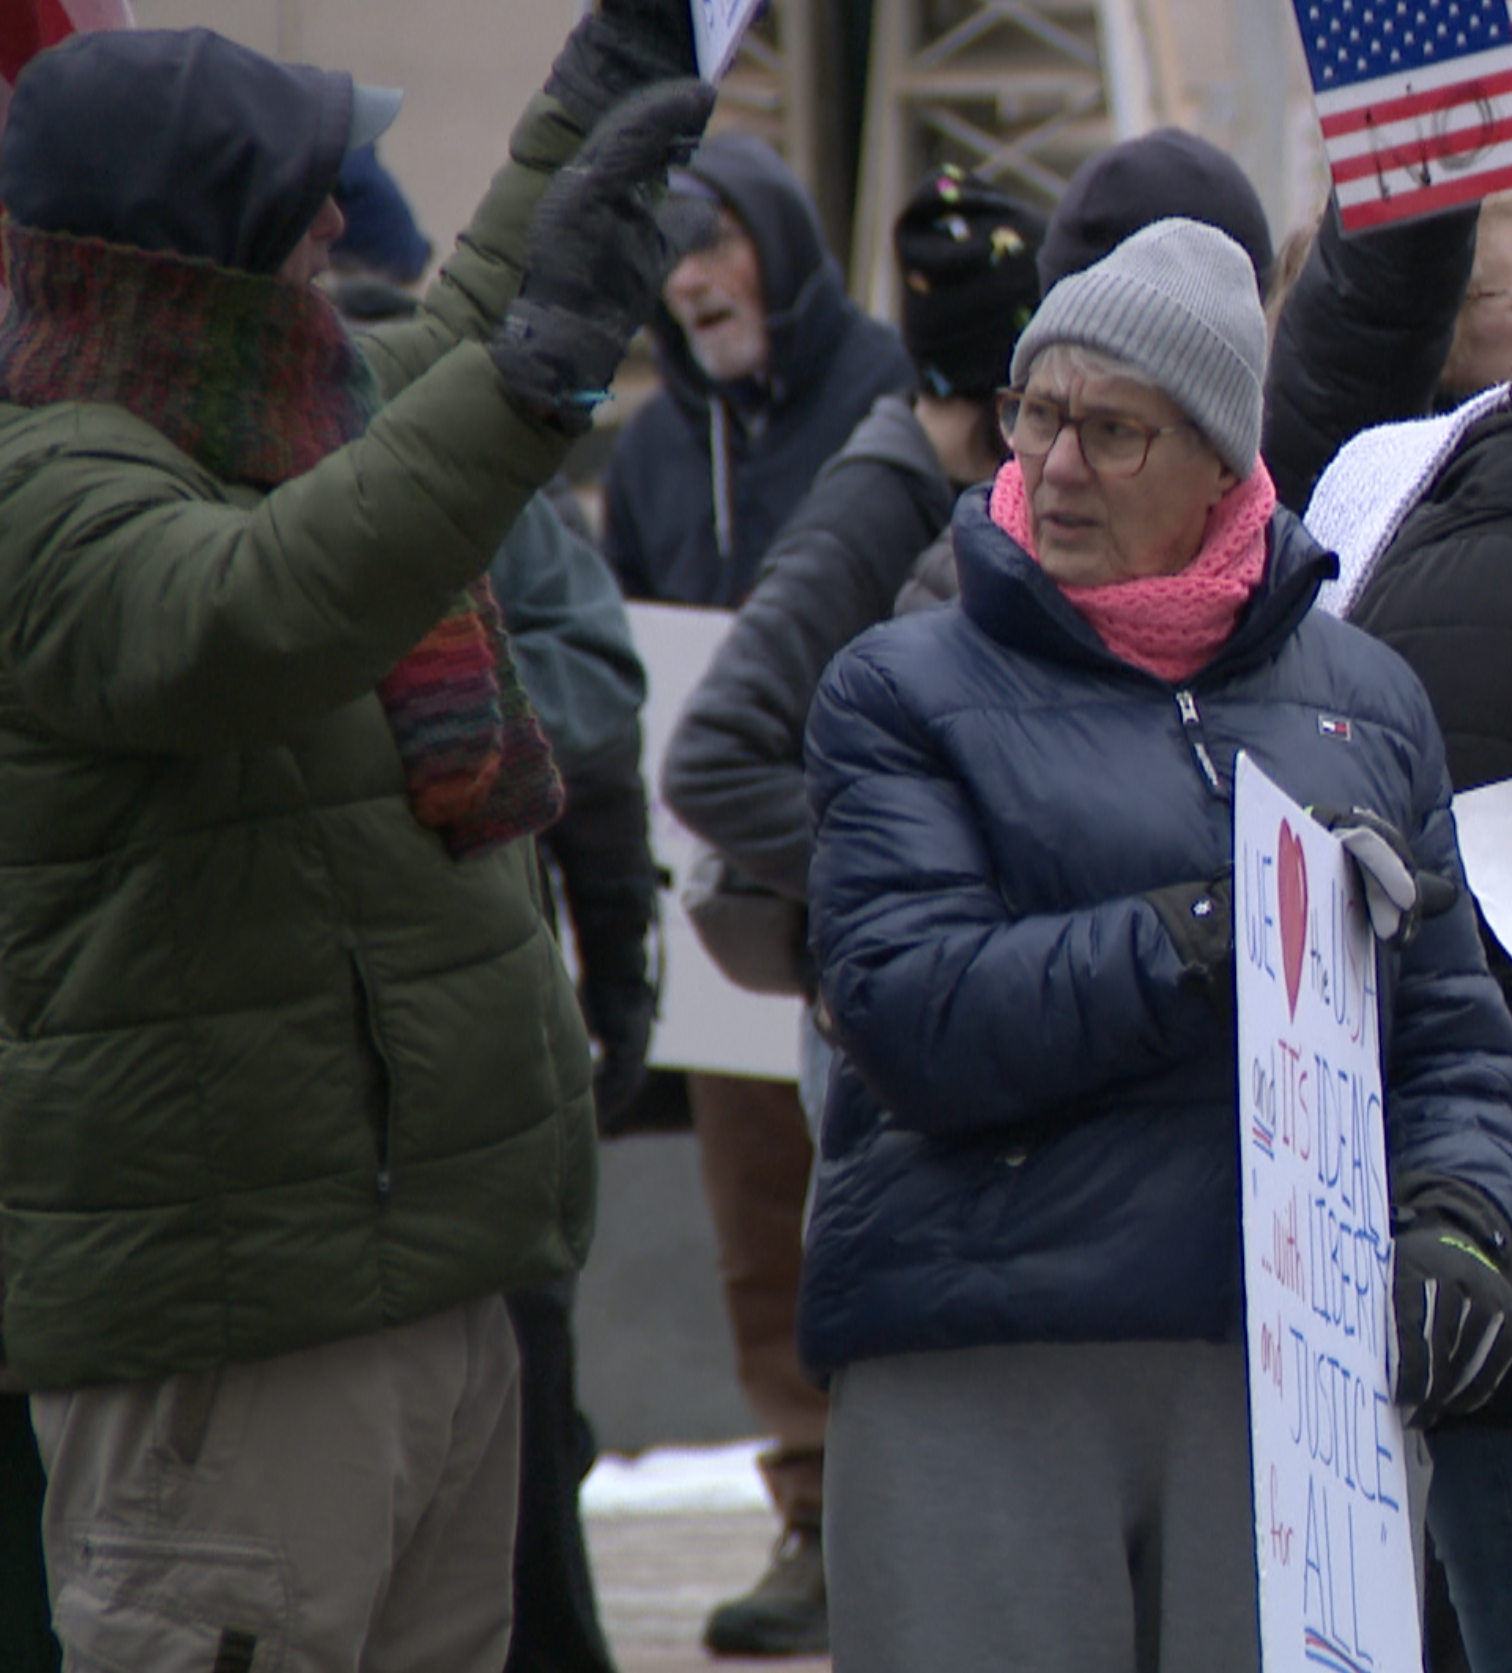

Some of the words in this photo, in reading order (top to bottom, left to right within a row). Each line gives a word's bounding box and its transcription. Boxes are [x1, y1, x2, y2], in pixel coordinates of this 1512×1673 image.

[1364, 82, 1498, 203] NO
[1244, 837, 1276, 984] WE
[1310, 907, 1332, 1006] the
[1252, 1046, 1277, 1135] and
[1261, 1311, 1283, 1401] and
[1289, 1324, 1399, 1513] JUSTICE
[1270, 1463, 1294, 1567] for
